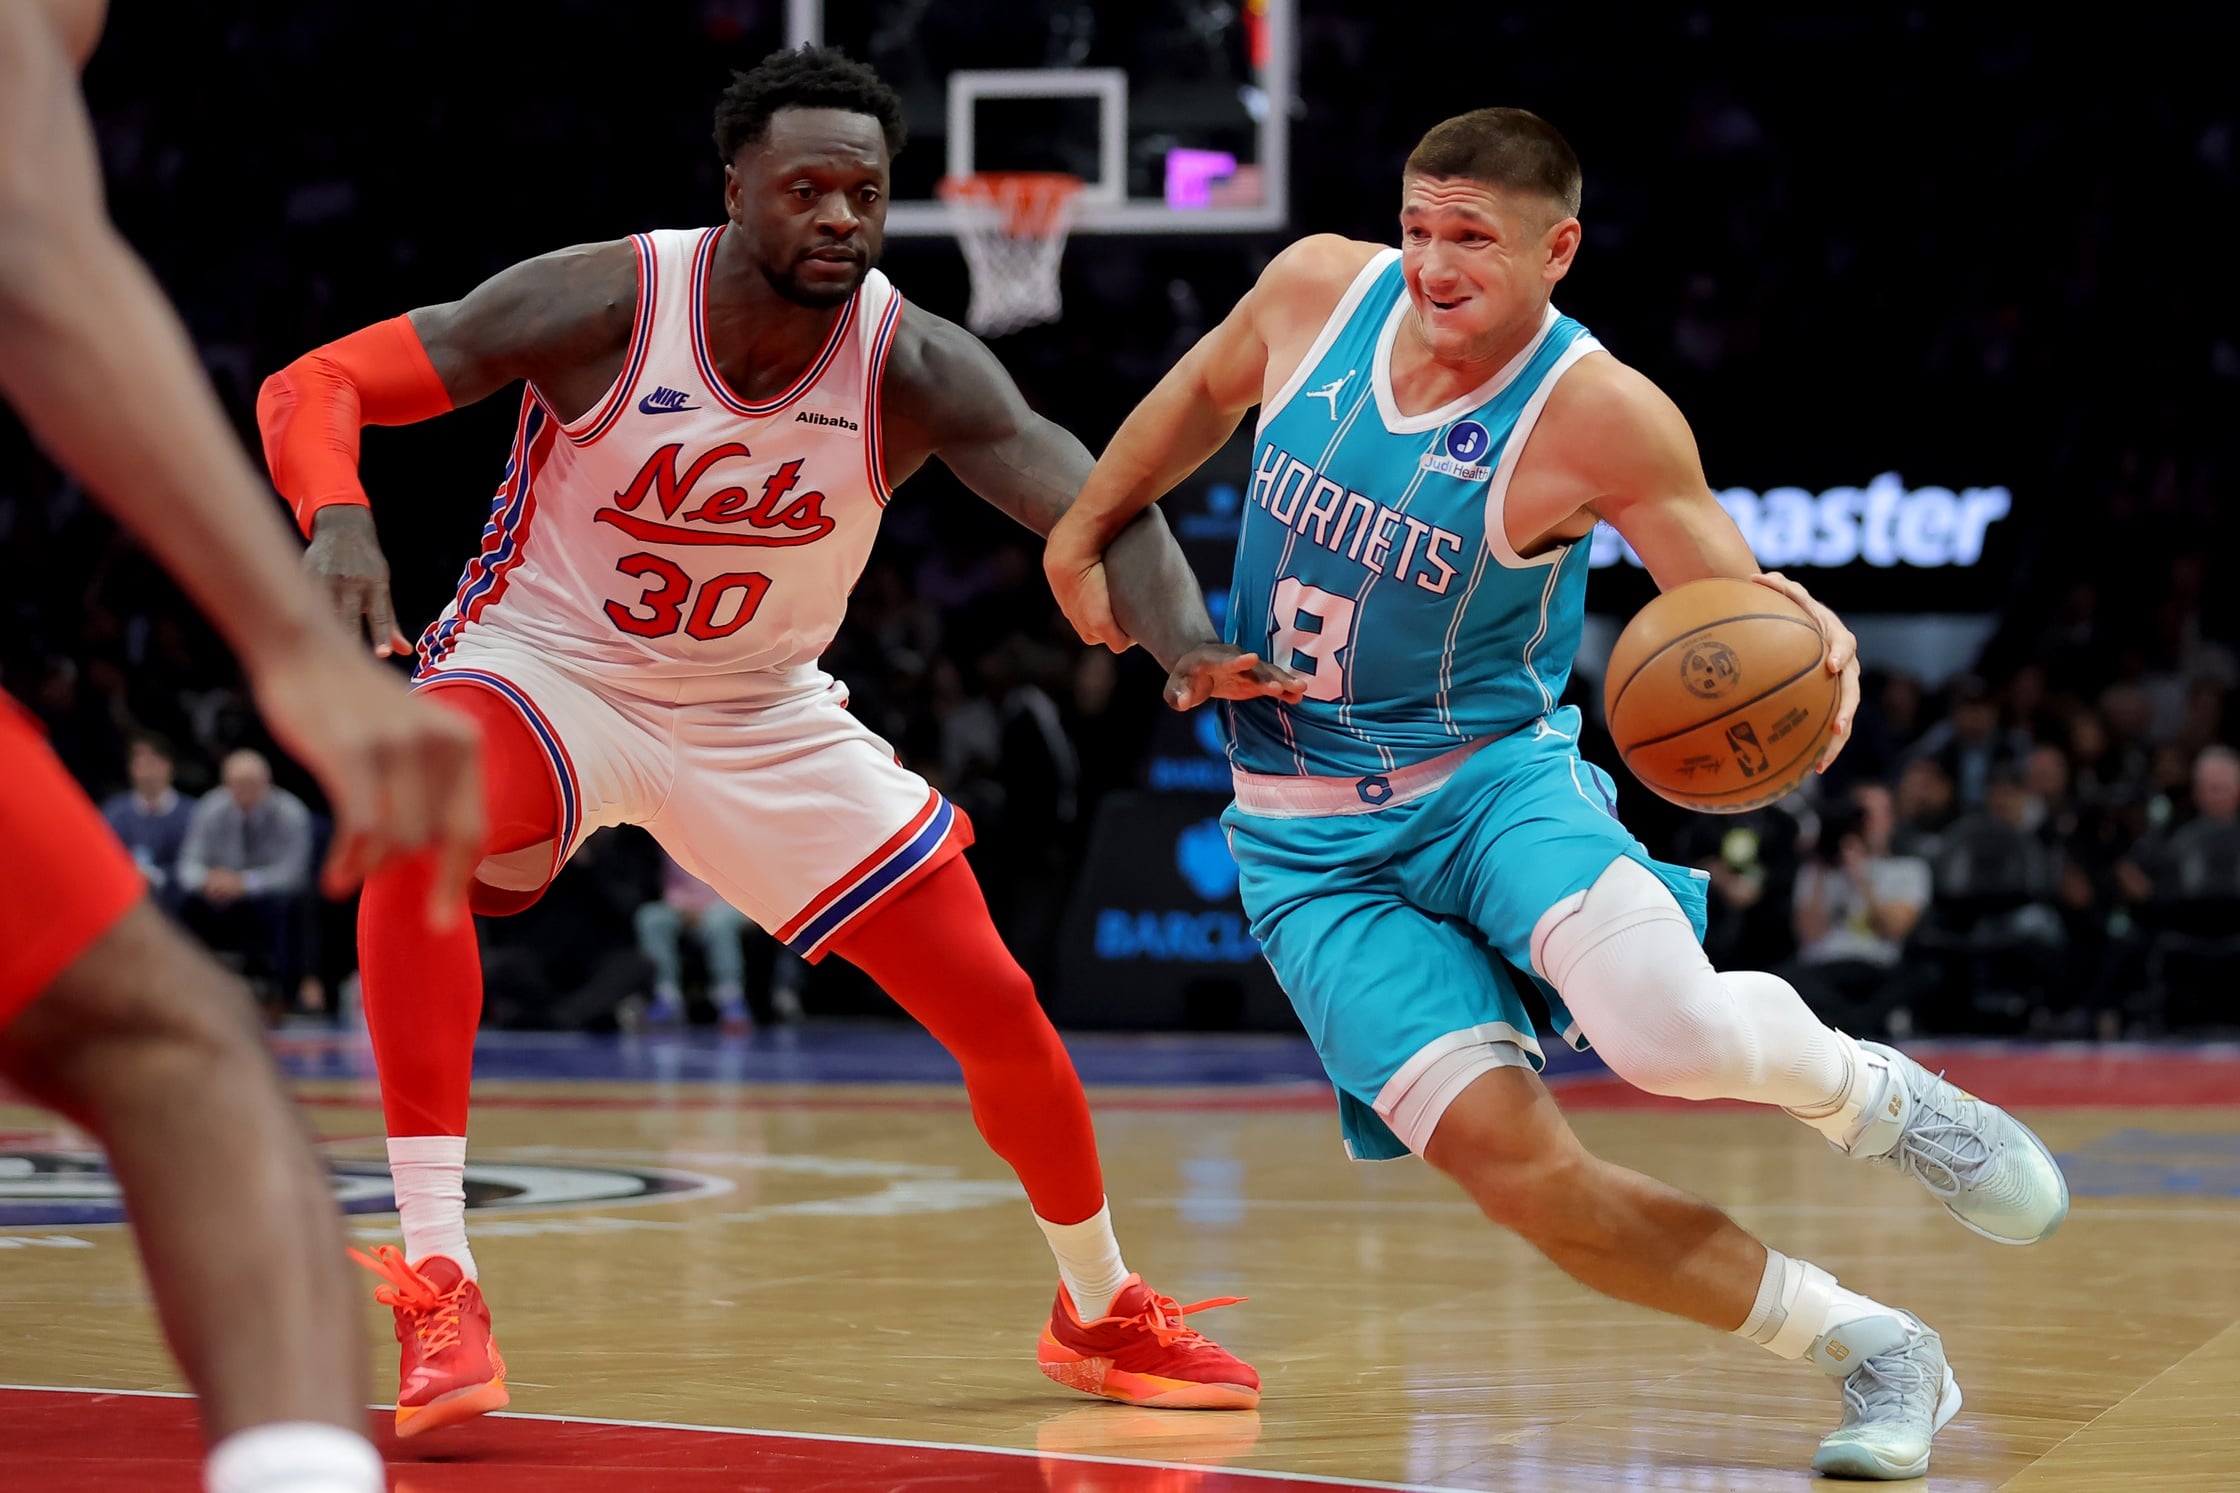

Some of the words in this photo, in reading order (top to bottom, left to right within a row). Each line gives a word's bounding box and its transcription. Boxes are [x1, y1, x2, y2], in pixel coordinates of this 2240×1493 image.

[650, 385, 690, 409] NIKE
[794, 411, 858, 431] Alibaba
[613, 442, 836, 532] Nets
[1425, 457, 1453, 474] Judi
[1453, 463, 1488, 480] Health
[1252, 442, 1464, 595] HORNETS
[1589, 471, 2012, 568] aster
[603, 552, 773, 641] 30
[1268, 575, 1358, 702] 8
